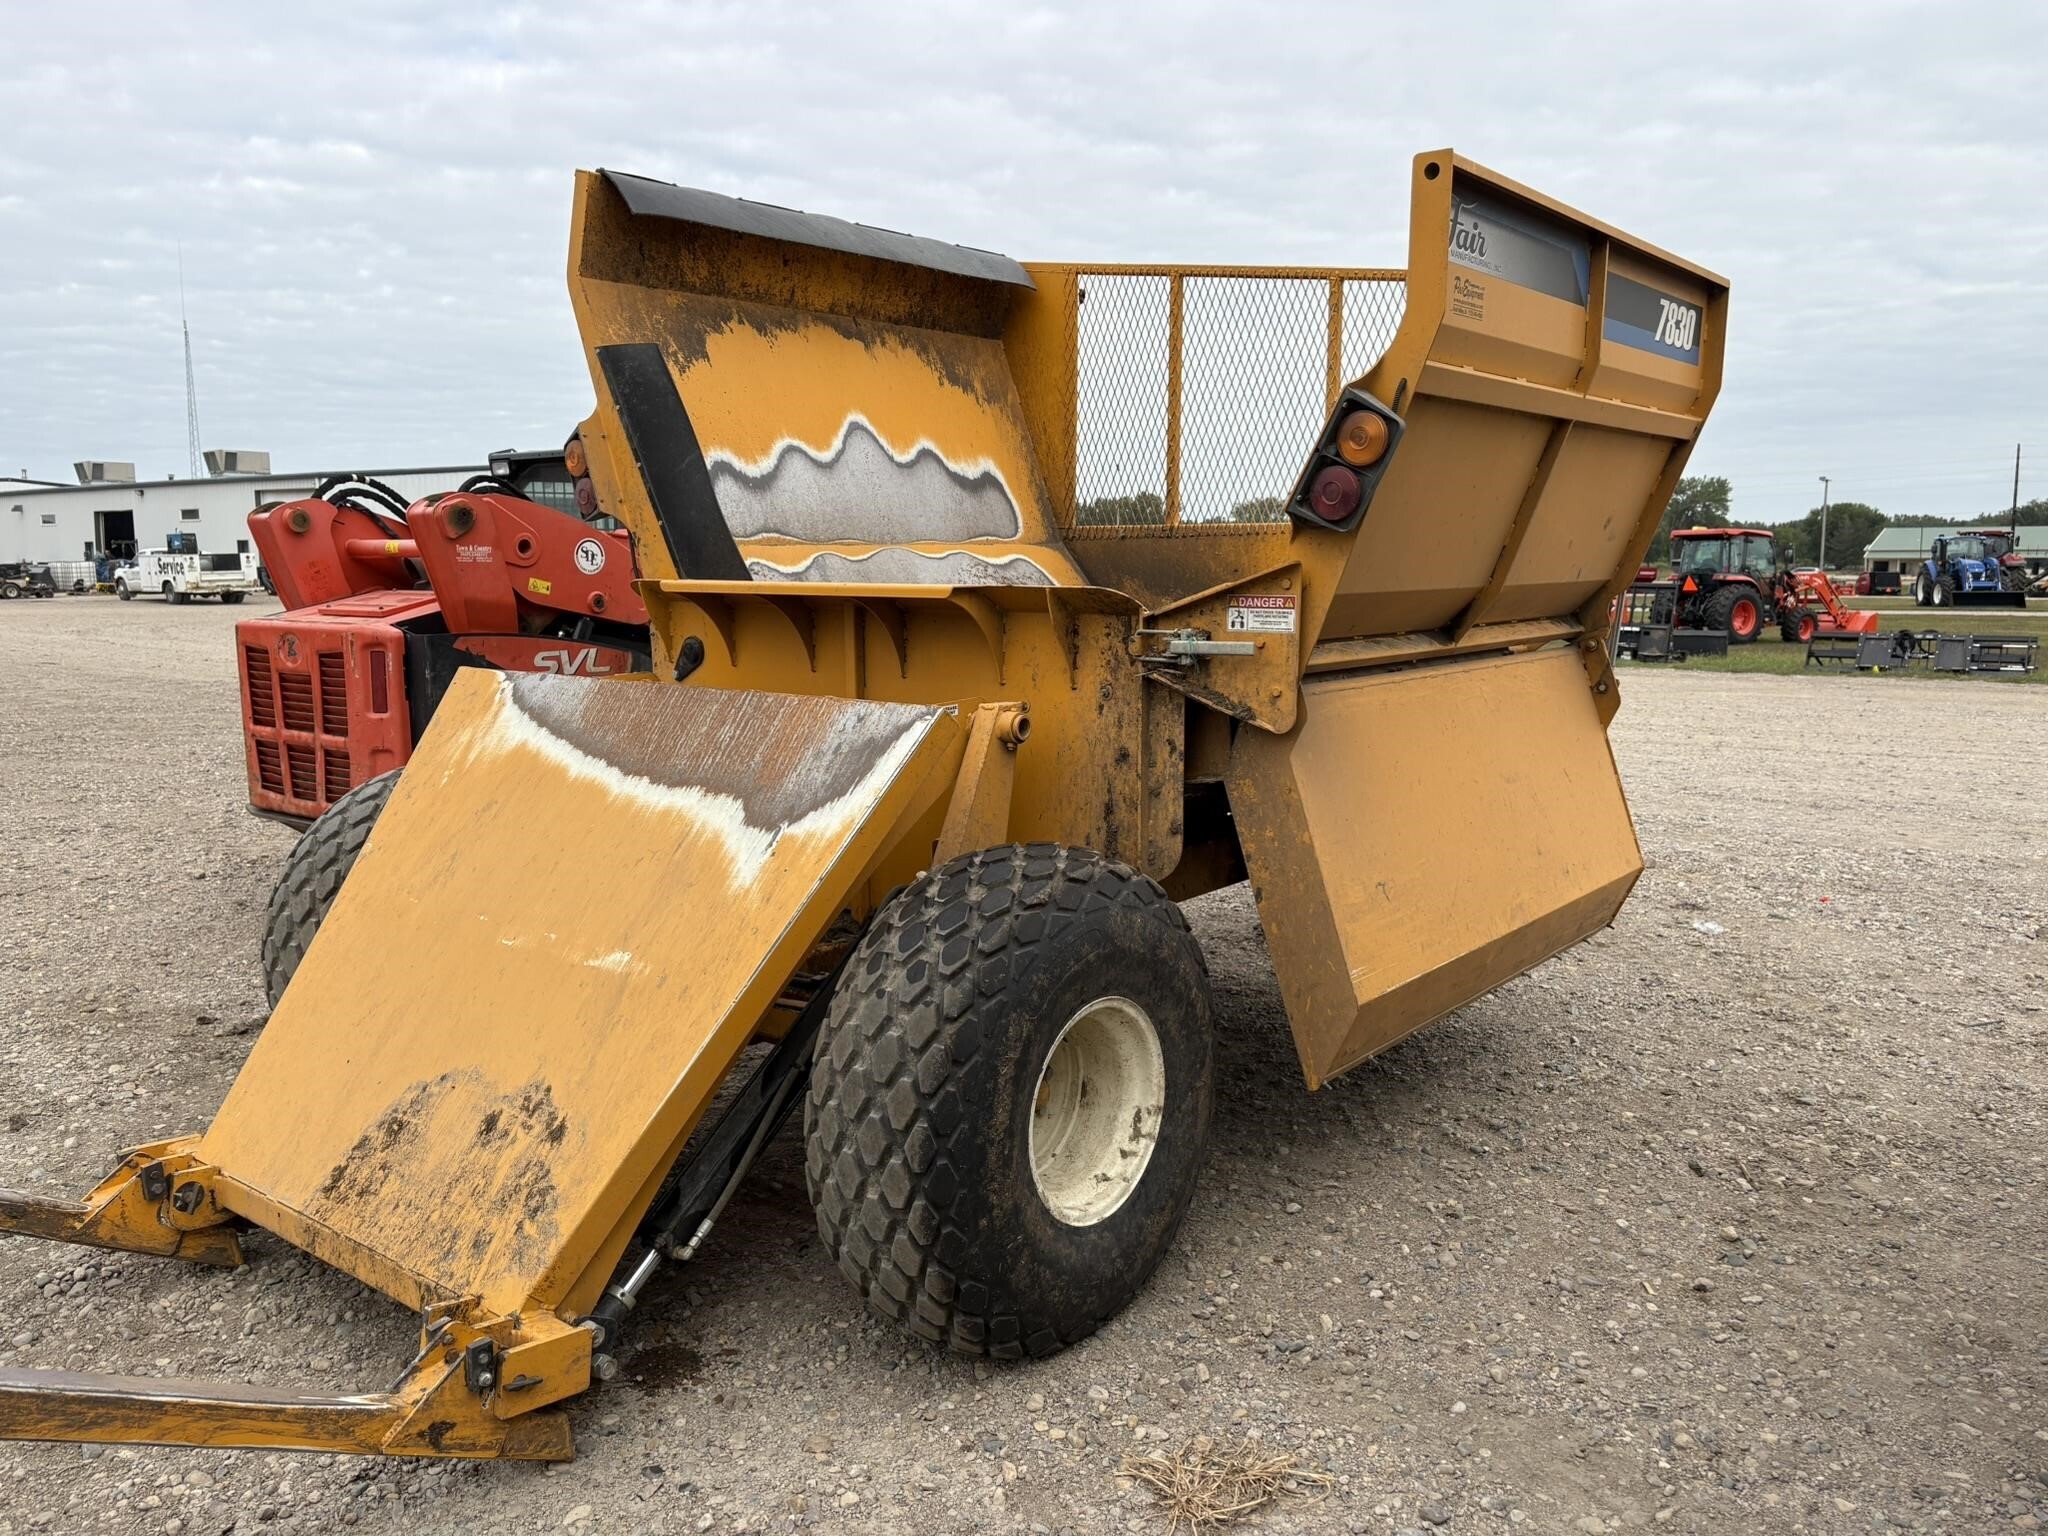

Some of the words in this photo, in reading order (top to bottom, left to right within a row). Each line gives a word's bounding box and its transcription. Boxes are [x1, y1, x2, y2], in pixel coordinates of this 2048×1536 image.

[1449, 194, 1488, 257] Fair
[1654, 298, 1696, 350] 7830
[158, 557, 184, 575] Service
[1239, 597, 1284, 608] DANGER
[534, 648, 610, 675] SVL
